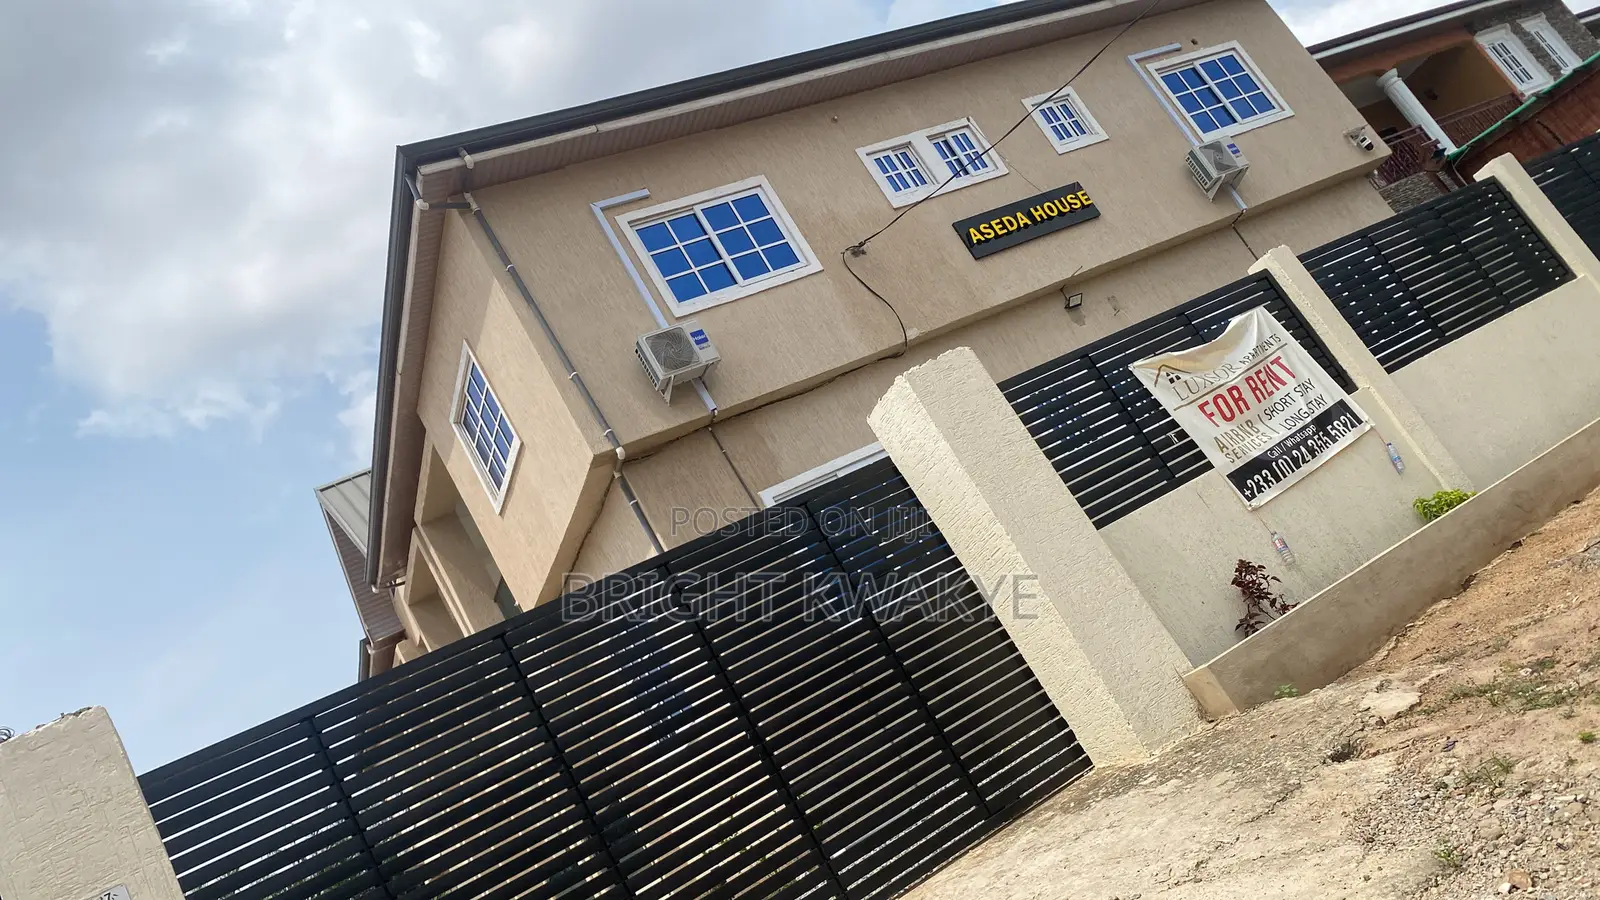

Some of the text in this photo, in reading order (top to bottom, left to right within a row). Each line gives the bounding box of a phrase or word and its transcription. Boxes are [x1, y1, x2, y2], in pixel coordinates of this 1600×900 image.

[968, 190, 1093, 244] ASEDA HOUSE
[1197, 355, 1296, 428] FOR RENT
[1213, 377, 1316, 454] AIRBNB SHORT STAY
[1224, 394, 1328, 464] SERVICES LONG STAY
[1243, 469, 1277, 498] +233
[1291, 445, 1313, 470] 24
[1307, 431, 1332, 457] 355
[1326, 412, 1361, 445] 5821
[1267, 444, 1283, 459] Call
[1283, 424, 1317, 448] Whatsapp
